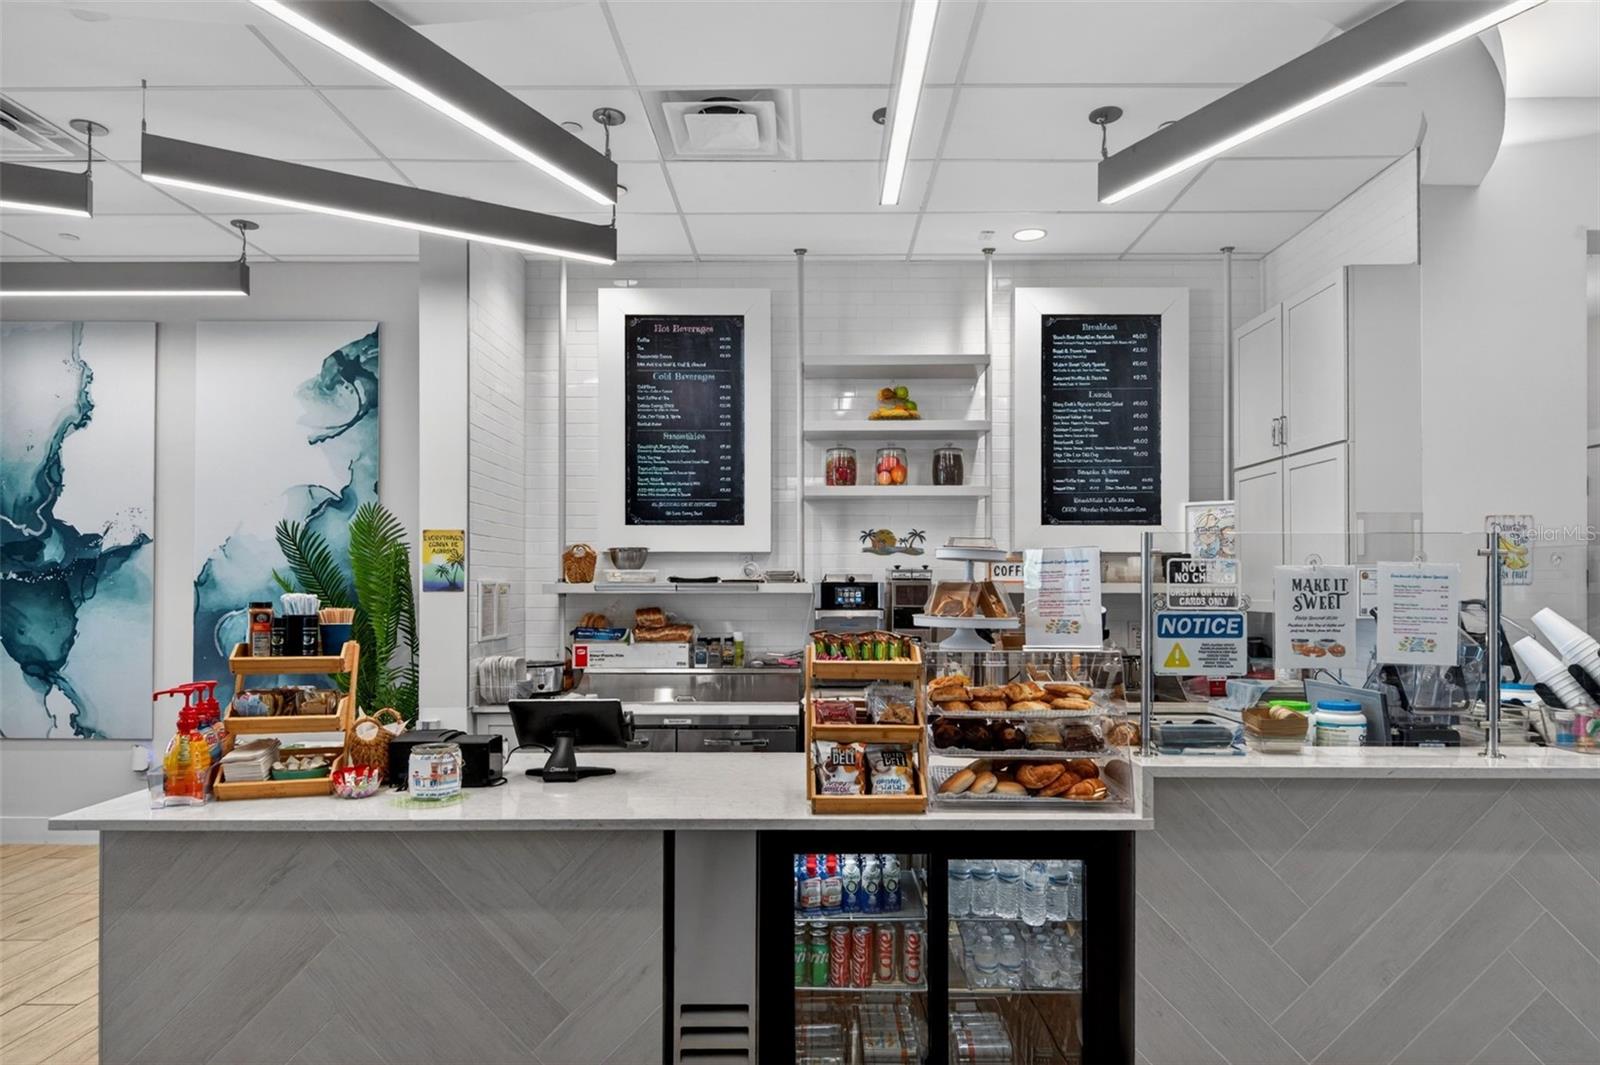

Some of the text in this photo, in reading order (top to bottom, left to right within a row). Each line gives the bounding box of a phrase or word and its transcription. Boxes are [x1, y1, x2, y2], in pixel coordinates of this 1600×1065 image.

[654, 324, 714, 334] Hot Beverages
[1082, 323, 1118, 331] Breakfast
[653, 372, 716, 382] Cold Beverages
[1088, 391, 1112, 399] Lunch
[663, 432, 706, 441] Smoothies
[994, 565, 1024, 577] COFF
[1181, 562, 1196, 572] NO
[1174, 572, 1190, 582] NO
[1292, 578, 1349, 595] MAKE IT
[1179, 597, 1228, 606] CARDS ONLY
[1292, 592, 1350, 612] SWEET
[1161, 617, 1241, 635] NOTICE
[832, 752, 855, 765] DELI
